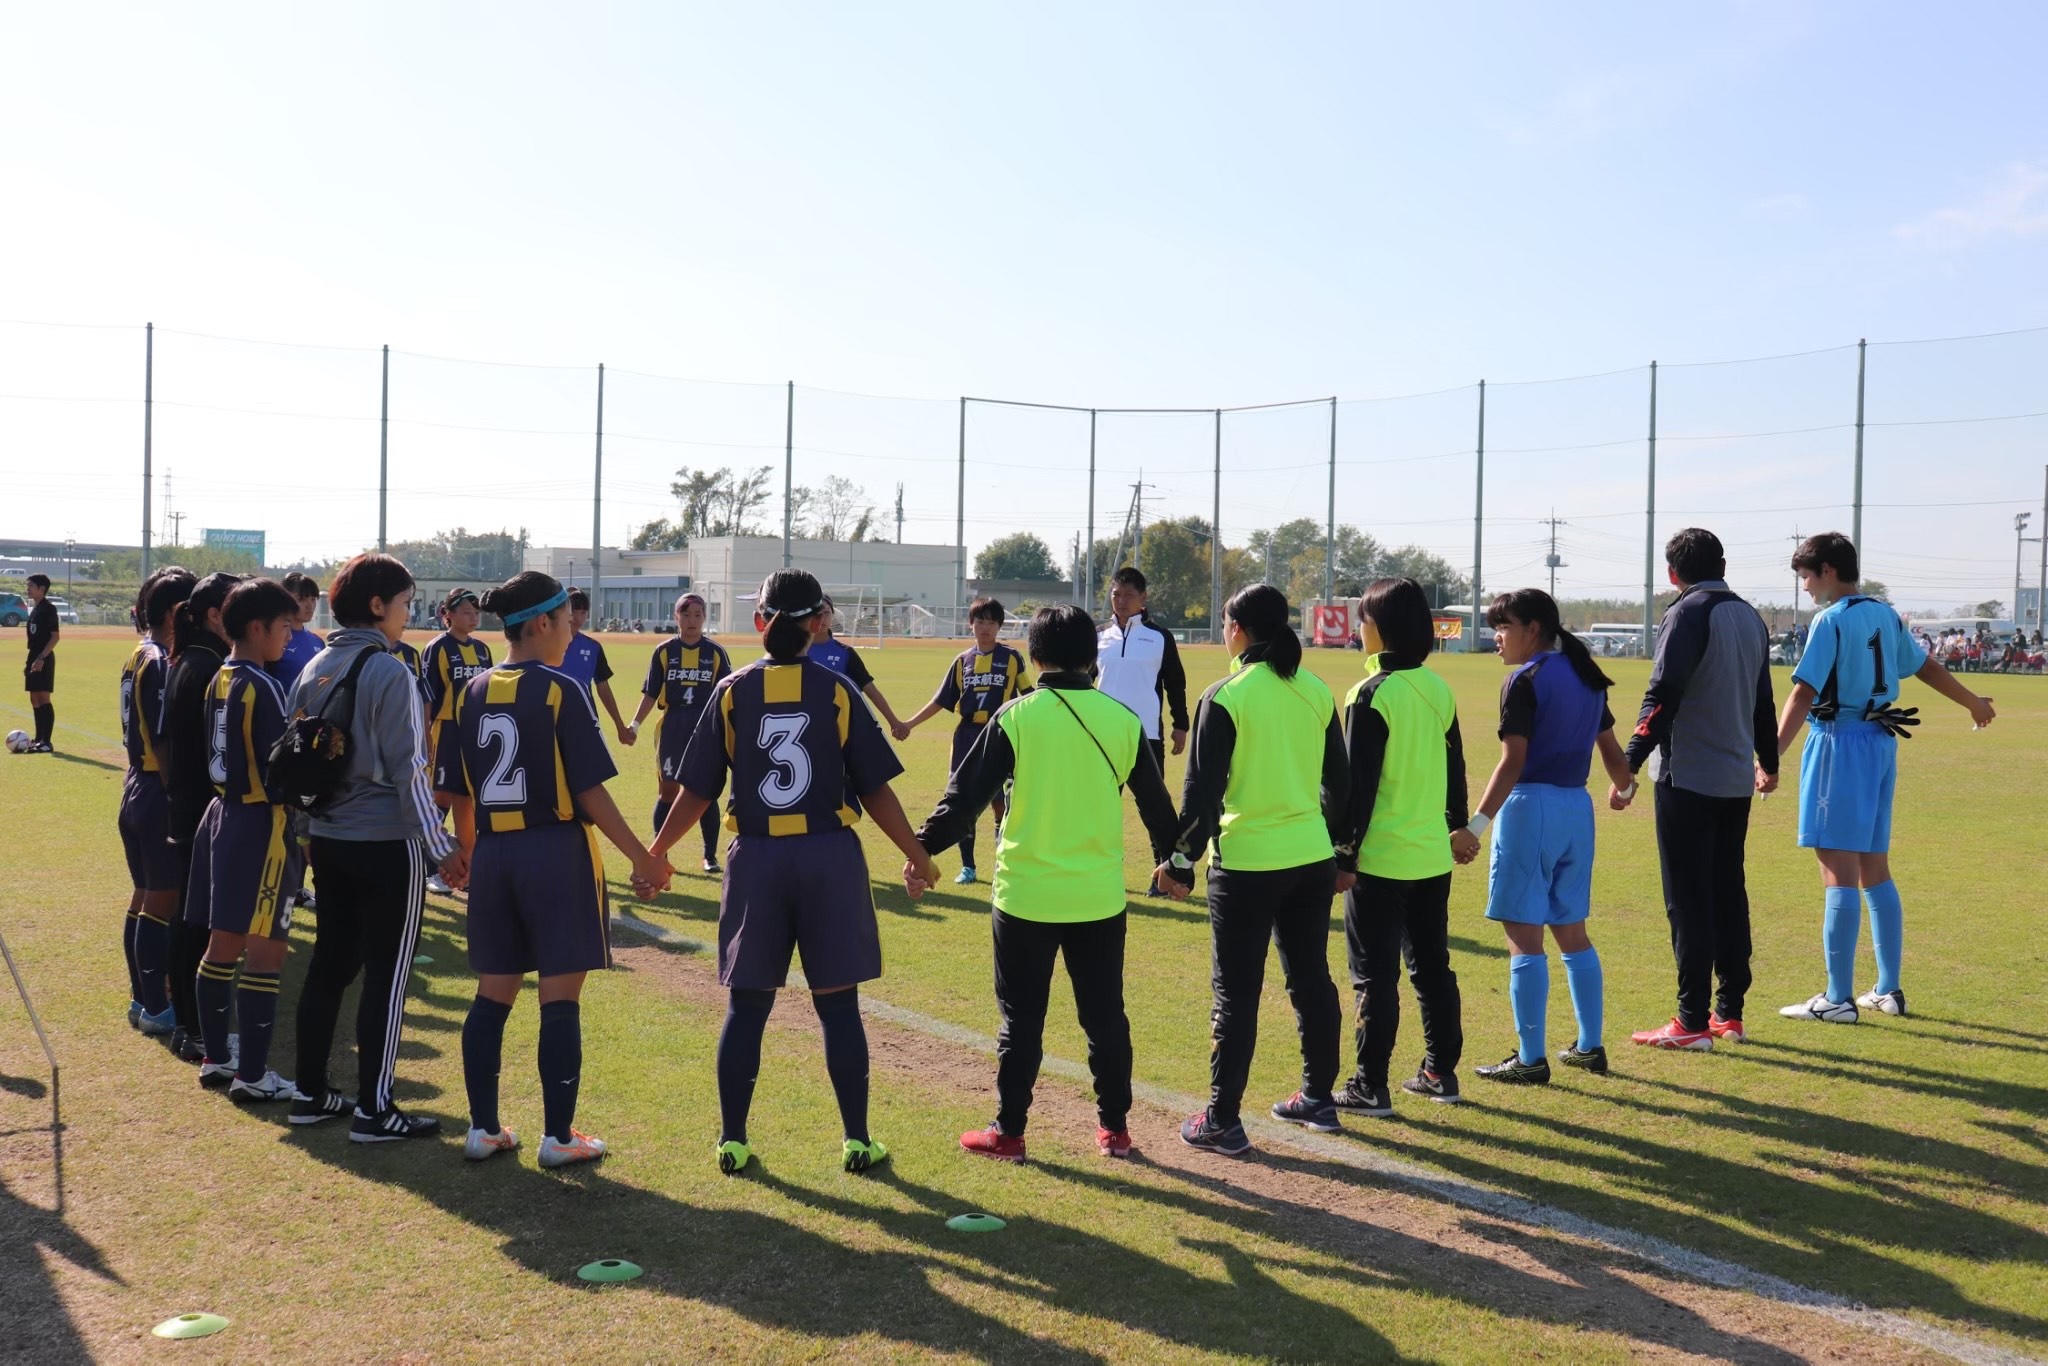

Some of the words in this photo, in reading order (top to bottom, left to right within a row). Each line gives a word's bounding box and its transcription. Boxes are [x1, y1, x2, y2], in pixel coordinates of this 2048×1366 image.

[1867, 627, 1888, 696] 1
[667, 668, 713, 682] 日本航空
[963, 673, 1006, 689] 日本航空
[682, 686, 695, 704] 4
[976, 692, 988, 710] 7
[477, 712, 527, 806] 2
[663, 756, 673, 776] 4
[757, 712, 812, 809] 3
